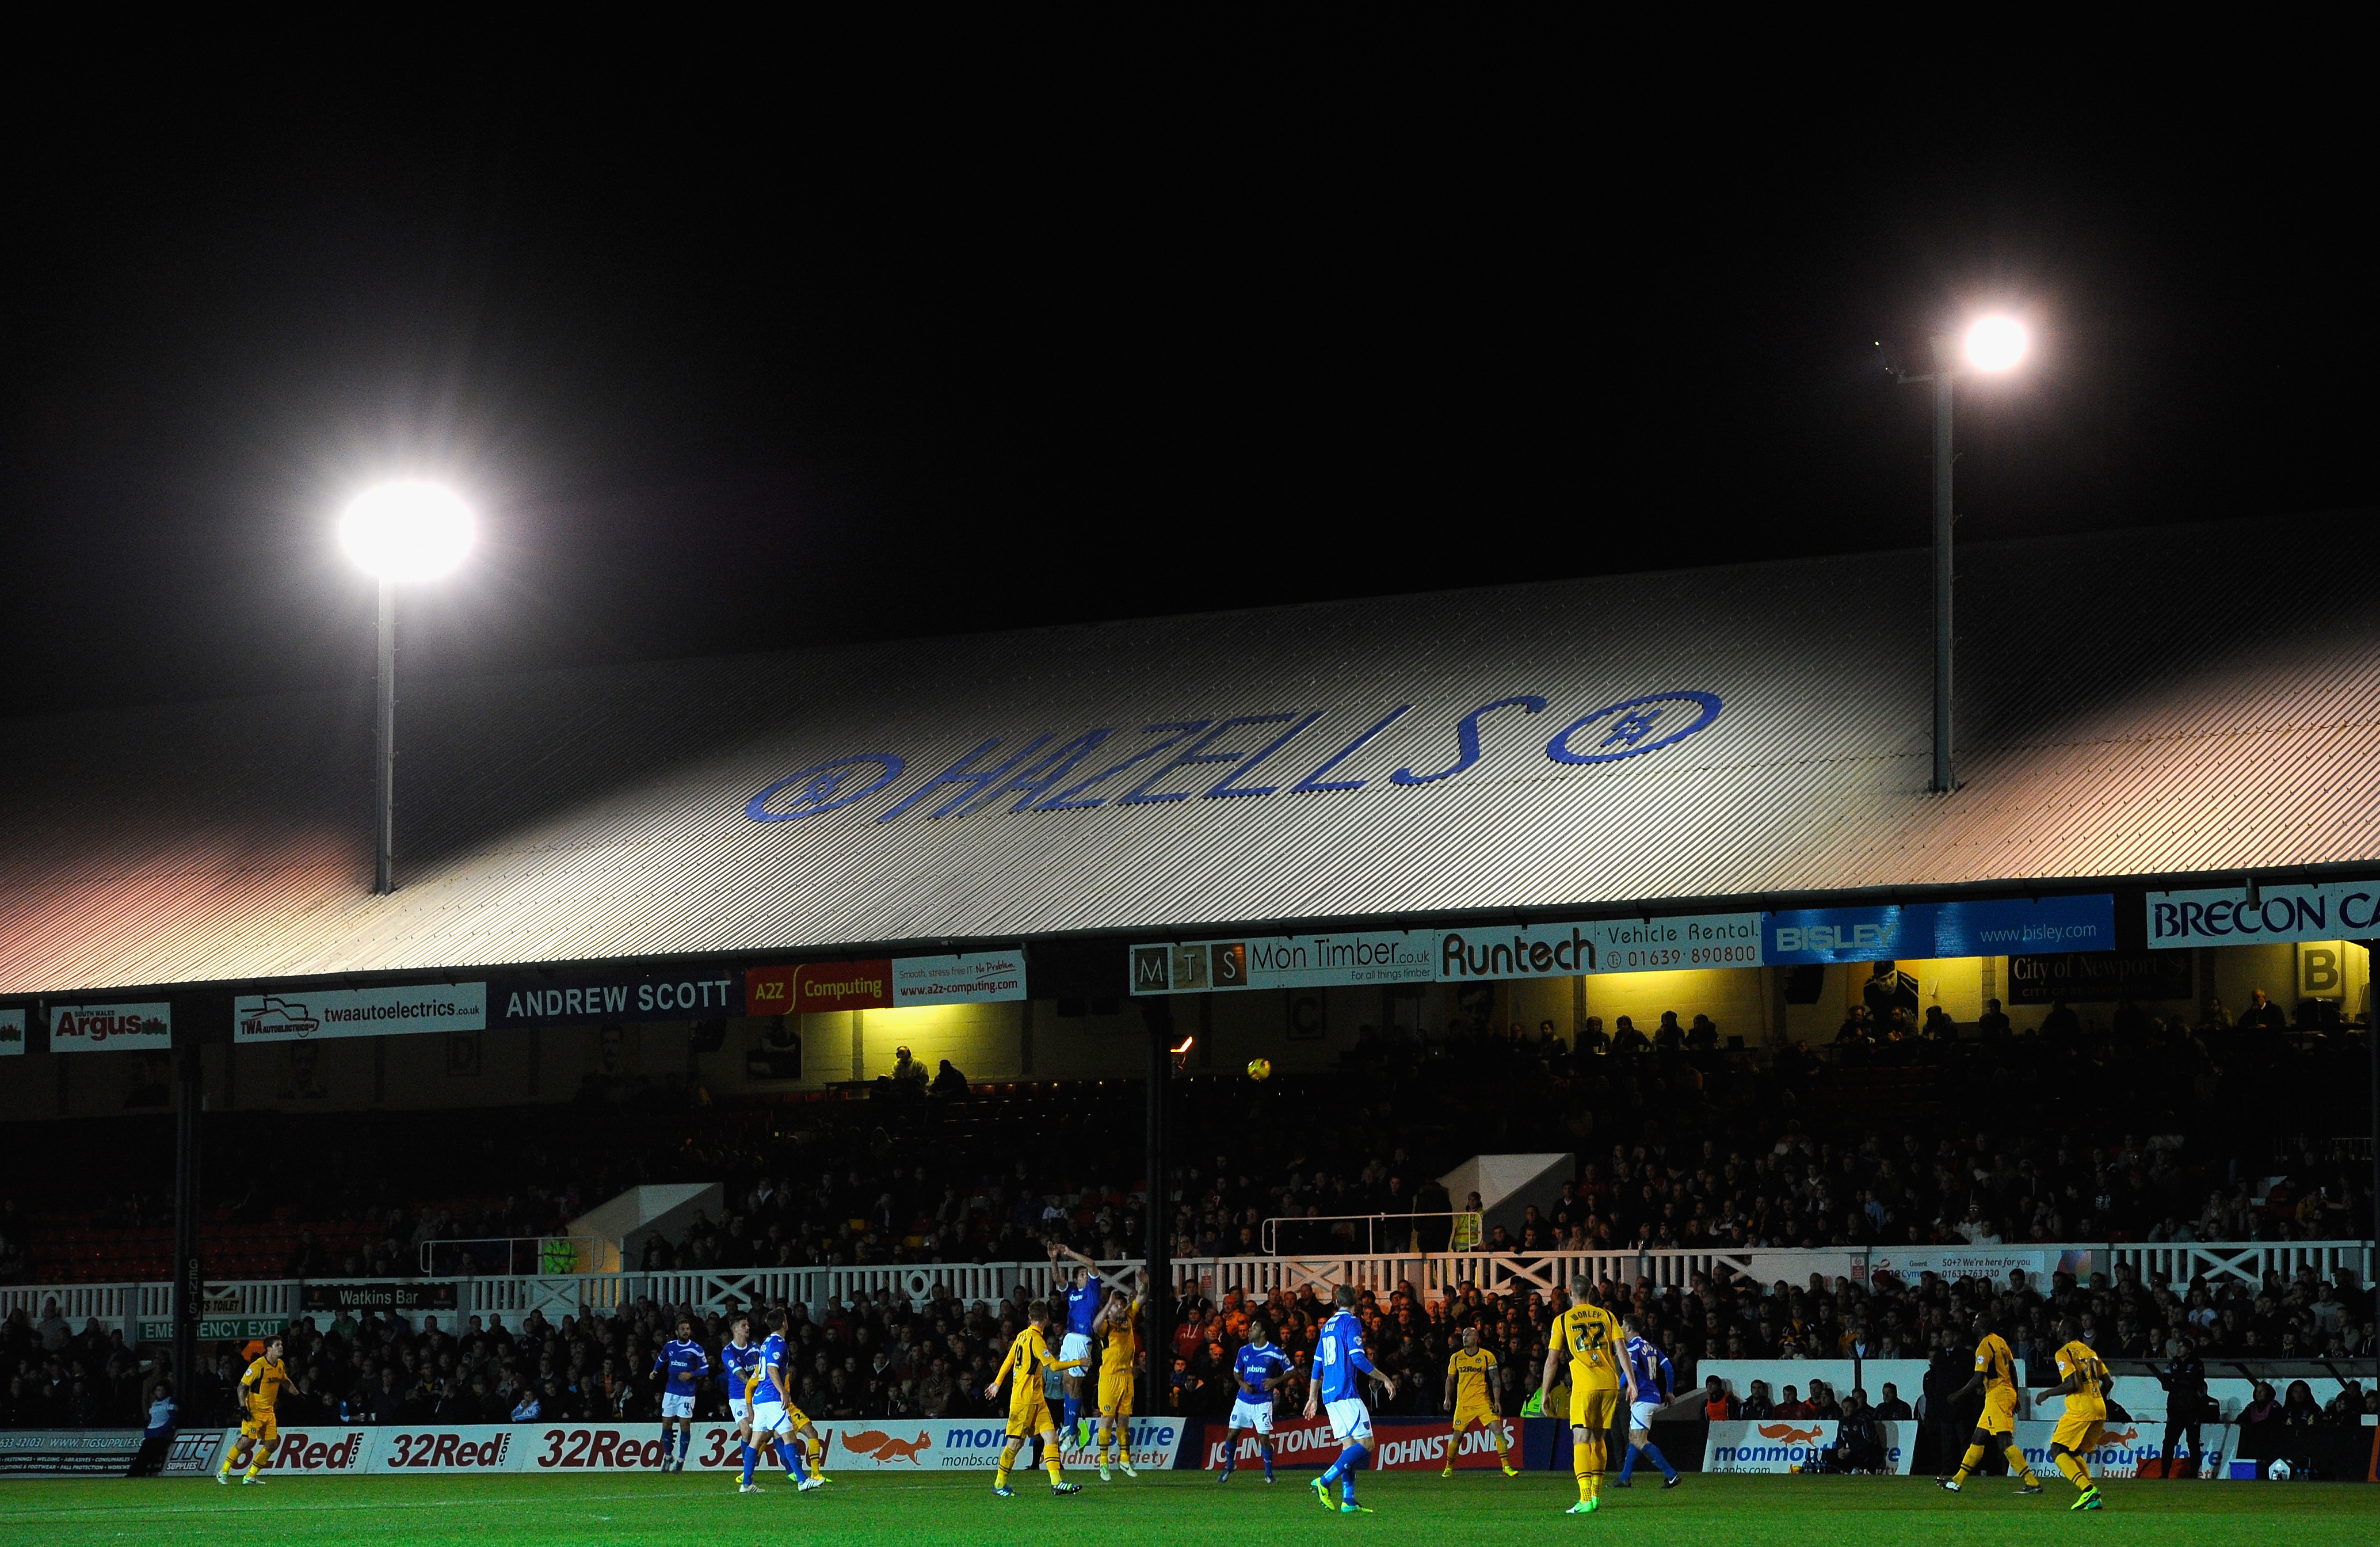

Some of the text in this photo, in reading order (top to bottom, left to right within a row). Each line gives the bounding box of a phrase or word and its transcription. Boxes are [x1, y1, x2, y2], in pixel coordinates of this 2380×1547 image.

[878, 695, 1548, 824] HAZELLS
[2154, 894, 2326, 939] BRECON
[1608, 923, 1677, 944] Vehicle
[1776, 922, 1895, 952] BISLEY
[1980, 923, 2096, 943] www.bisley.com
[1252, 938, 1430, 971] Mon Timber.co.uk
[1442, 927, 1596, 977] Runtech
[1628, 949, 1681, 967] 01639
[1691, 946, 1755, 965] 890800
[899, 969, 926, 980] Smooth,
[928, 967, 948, 977] stress
[949, 966, 965, 976] free
[967, 966, 973, 974] IT
[976, 965, 987, 974] No
[1140, 951, 1235, 984] M T S
[1351, 968, 1431, 981] For all things timber
[2013, 954, 2159, 985] City of Newport
[2305, 949, 2339, 992] B
[755, 977, 883, 1001] A2Z Computing
[900, 978, 1018, 997] www.a2z-computing.com
[506, 980, 733, 1018] ANDREW SCOTT
[325, 999, 479, 1023] twaautoelectrics.co.uk
[56, 1012, 142, 1041] Argus
[241, 1020, 262, 1035] TWA
[1963, 1258, 1984, 1267] We're
[1985, 1258, 2002, 1266] here
[2003, 1258, 2015, 1268] for
[2016, 1259, 2030, 1268] you
[1985, 1269, 1999, 1277] 330
[189, 1259, 199, 1314] GENTS
[213, 1300, 239, 1312] TOILET
[340, 1289, 419, 1305] Watkins Bar
[1570, 1310, 1602, 1321] WORLEY
[146, 1320, 281, 1339] EMEENCY EXIT
[1570, 1321, 1606, 1352] 22
[1322, 1335, 1336, 1366] 18
[670, 1359, 688, 1367] jobsite
[1247, 1365, 1266, 1374] jobsite
[684, 1402, 689, 1411] 4
[1262, 1413, 1267, 1422] 7
[16, 1438, 45, 1447] 421031
[348, 1431, 364, 1469] .com
[387, 1432, 512, 1468] 32Red .com
[166, 1462, 197, 1470] SUPPLIES
[942, 1452, 1000, 1466] monbs.co
[1109, 1450, 1169, 1466] sciety
